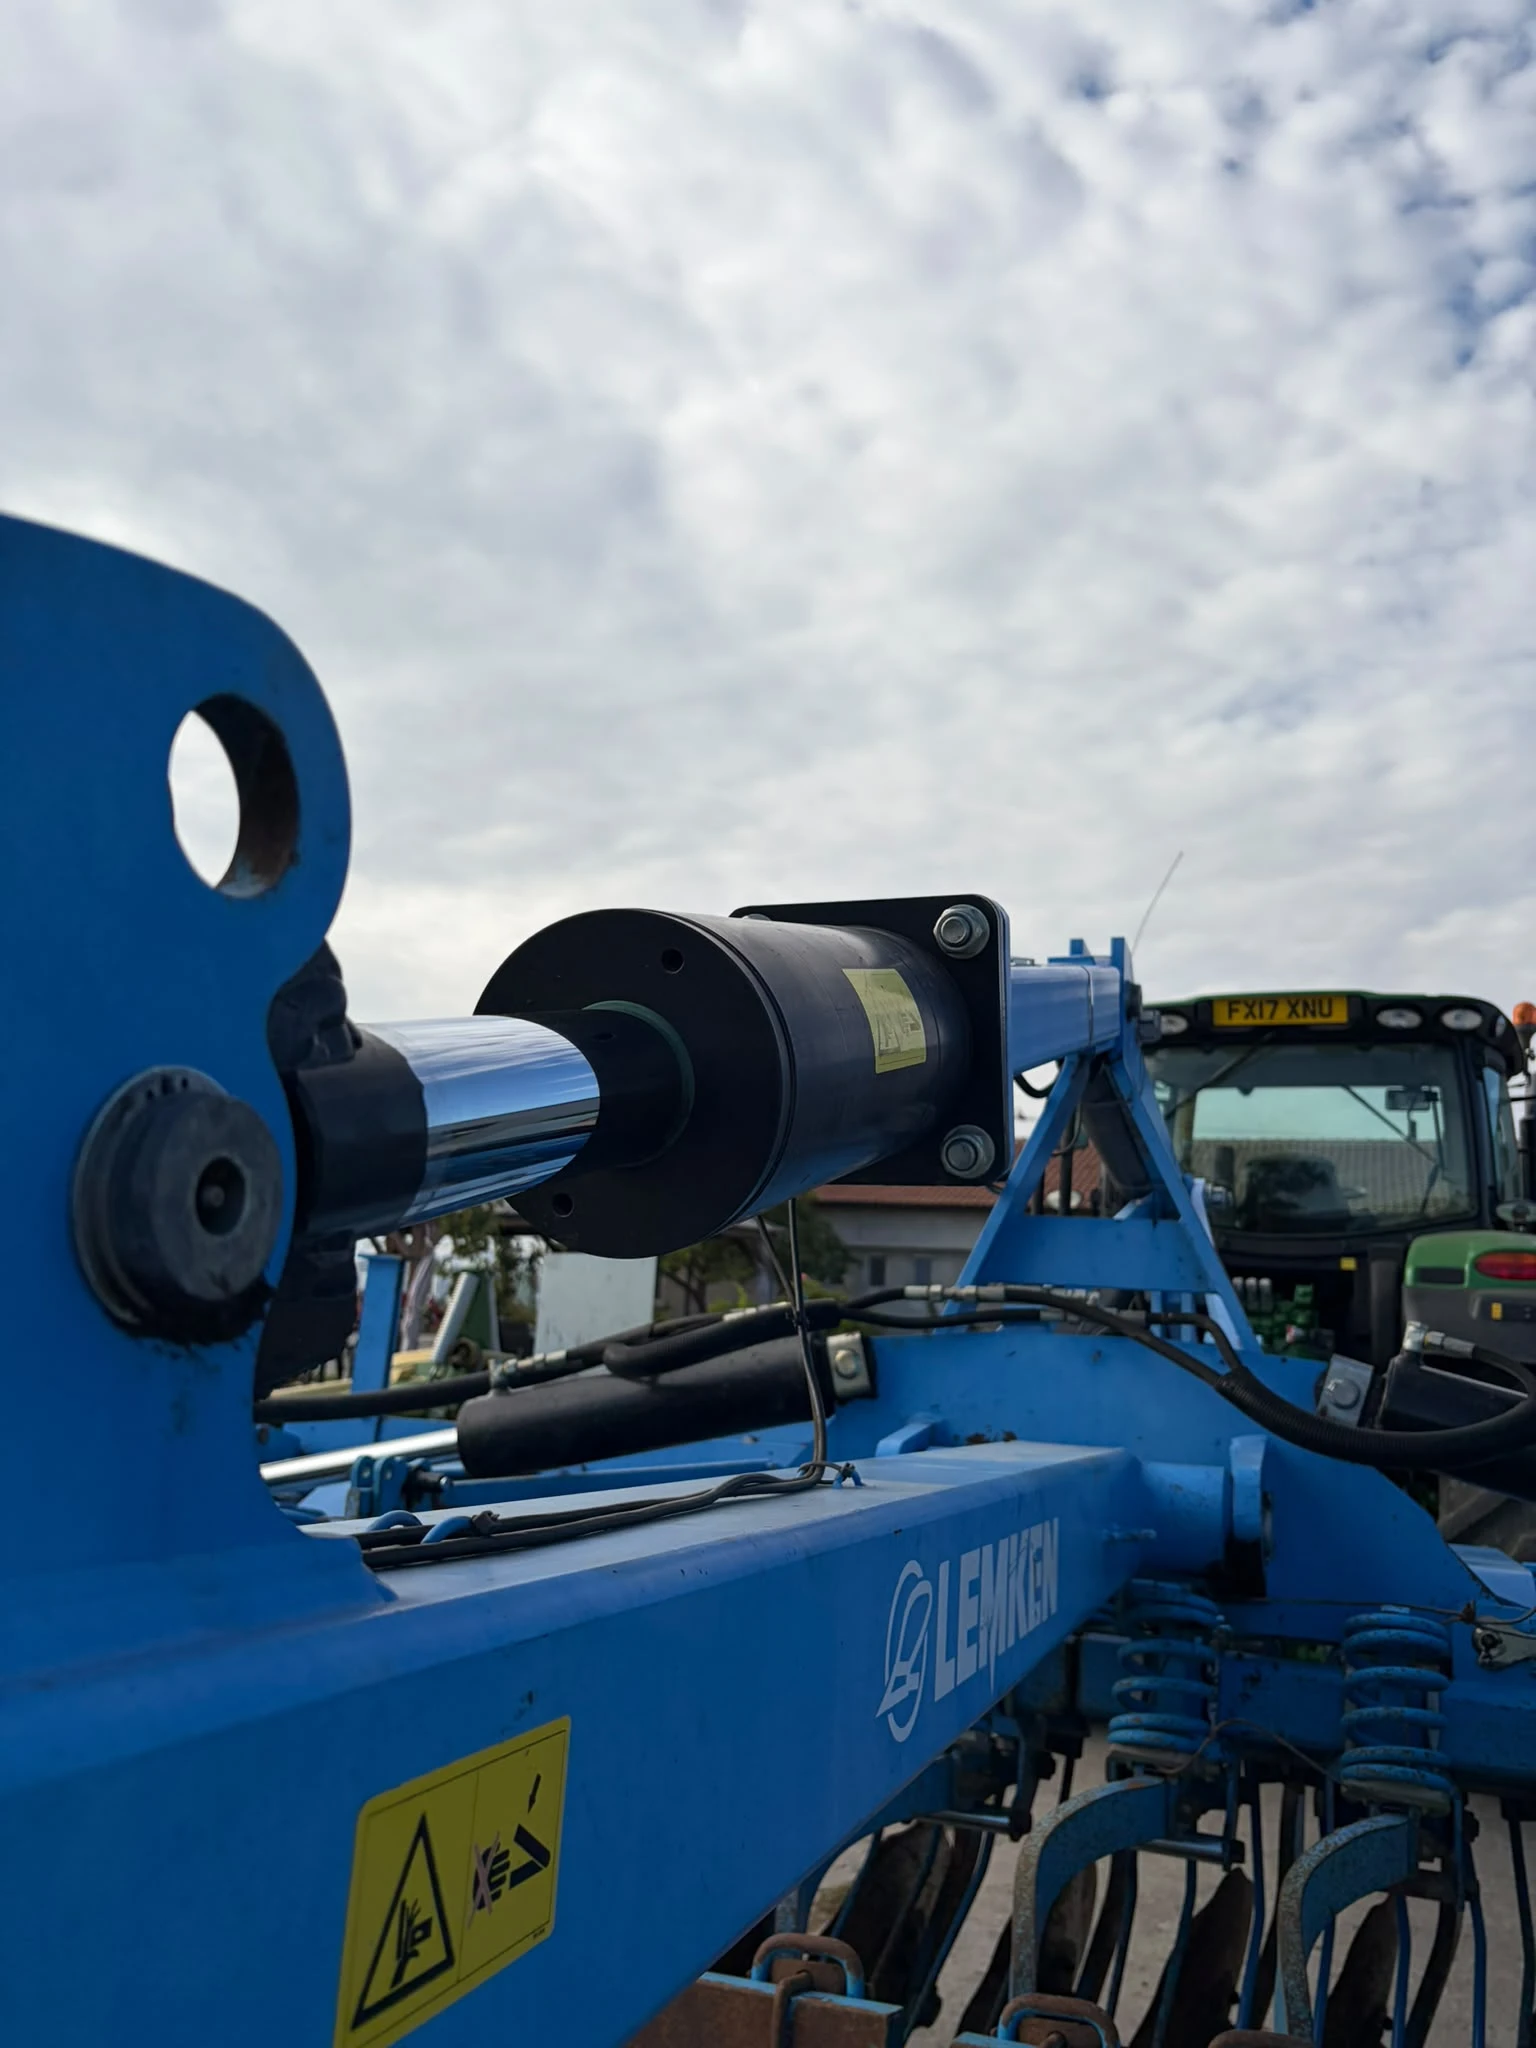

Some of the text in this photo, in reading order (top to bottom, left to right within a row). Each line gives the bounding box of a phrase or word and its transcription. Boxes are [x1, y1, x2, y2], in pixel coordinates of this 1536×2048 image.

[1227, 998, 1333, 1020] FX17 XNU
[934, 1517, 1059, 1703] LEMKEN
